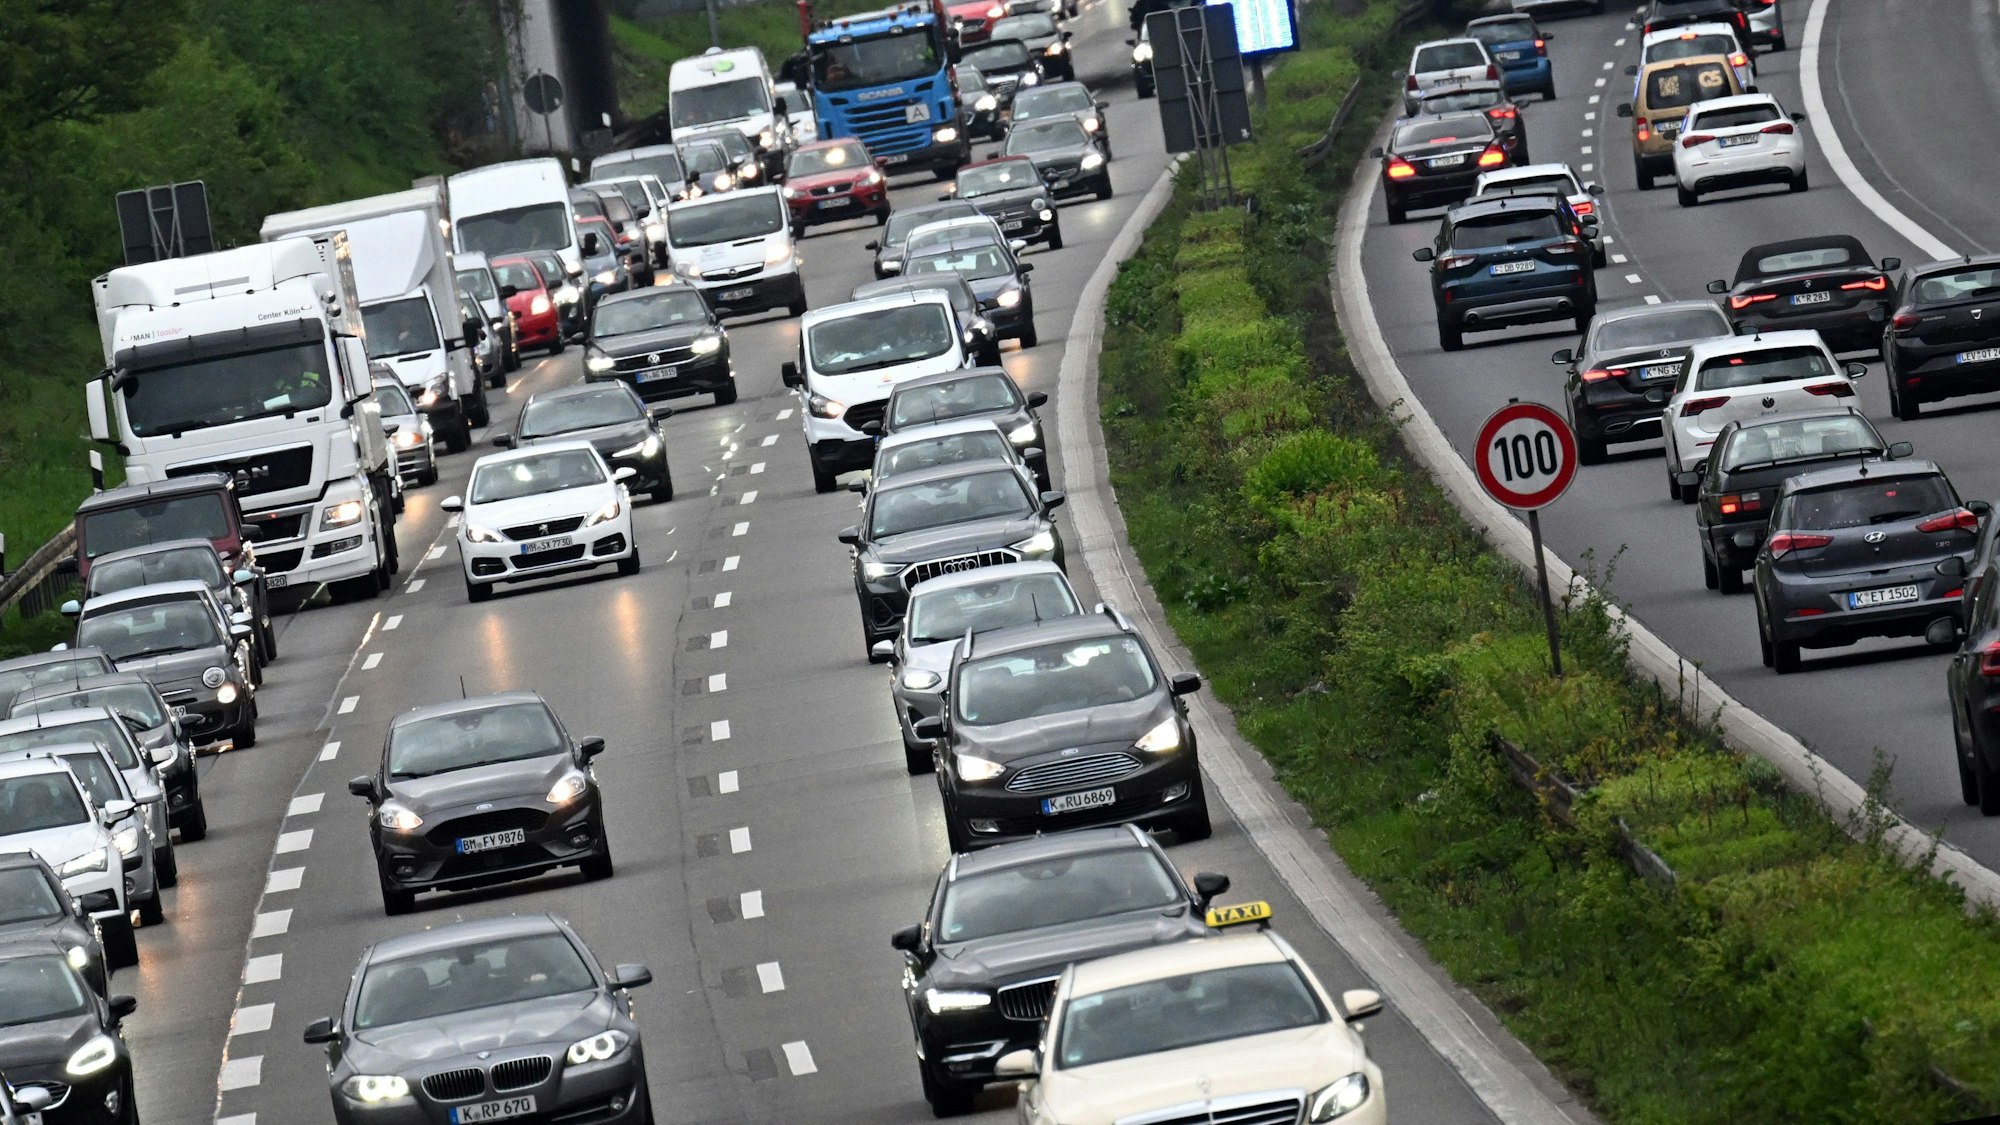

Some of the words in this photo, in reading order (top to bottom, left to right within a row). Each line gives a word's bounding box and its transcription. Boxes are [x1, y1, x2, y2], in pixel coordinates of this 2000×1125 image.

[912, 106, 925, 119] A
[1515, 261, 1534, 271] 9289
[1813, 292, 1829, 302] 283
[257, 311, 282, 321] Center
[284, 308, 301, 318] Köln
[133, 332, 151, 341] MAN
[1961, 351, 1976, 361] LEV
[1657, 366, 1670, 376] NG
[1494, 430, 1558, 482] 100
[541, 541, 551, 550] SX
[552, 537, 571, 549] 7730
[1856, 593, 1864, 605] K
[1871, 590, 1885, 603] ET
[1888, 586, 1916, 600] 1502
[1049, 798, 1058, 811] K
[1065, 795, 1082, 808] RU
[1083, 789, 1113, 805] 6869
[463, 839, 477, 851] BM
[483, 835, 496, 847] FY
[497, 830, 523, 844] 9876
[1214, 903, 1262, 922] TAXI
[462, 1106, 473, 1121] K
[481, 1102, 500, 1118] RP
[503, 1097, 531, 1115] 670
